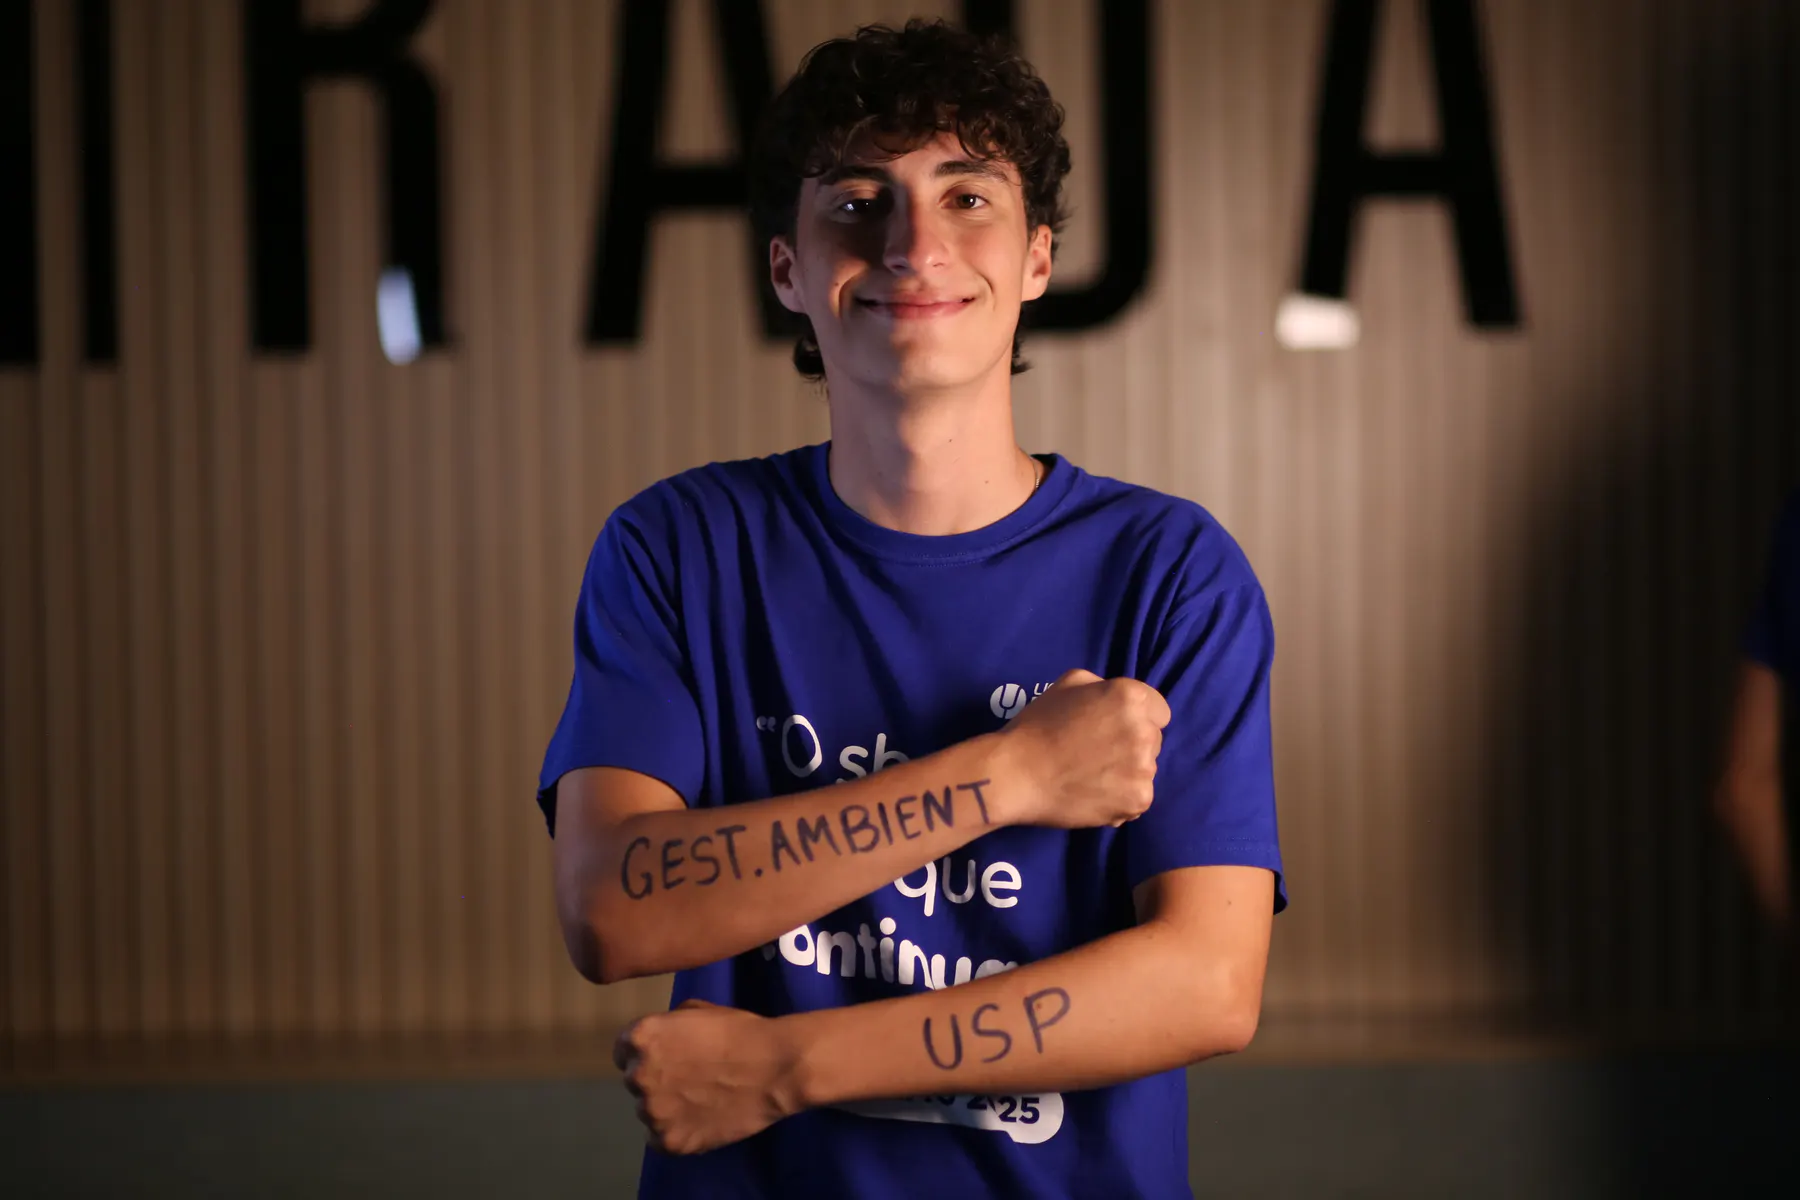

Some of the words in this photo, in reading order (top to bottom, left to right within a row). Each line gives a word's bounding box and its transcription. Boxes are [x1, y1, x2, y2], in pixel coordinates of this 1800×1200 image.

[893, 857, 1023, 917] que
[762, 917, 1020, 990] ontinu
[922, 986, 1071, 1071] USP
